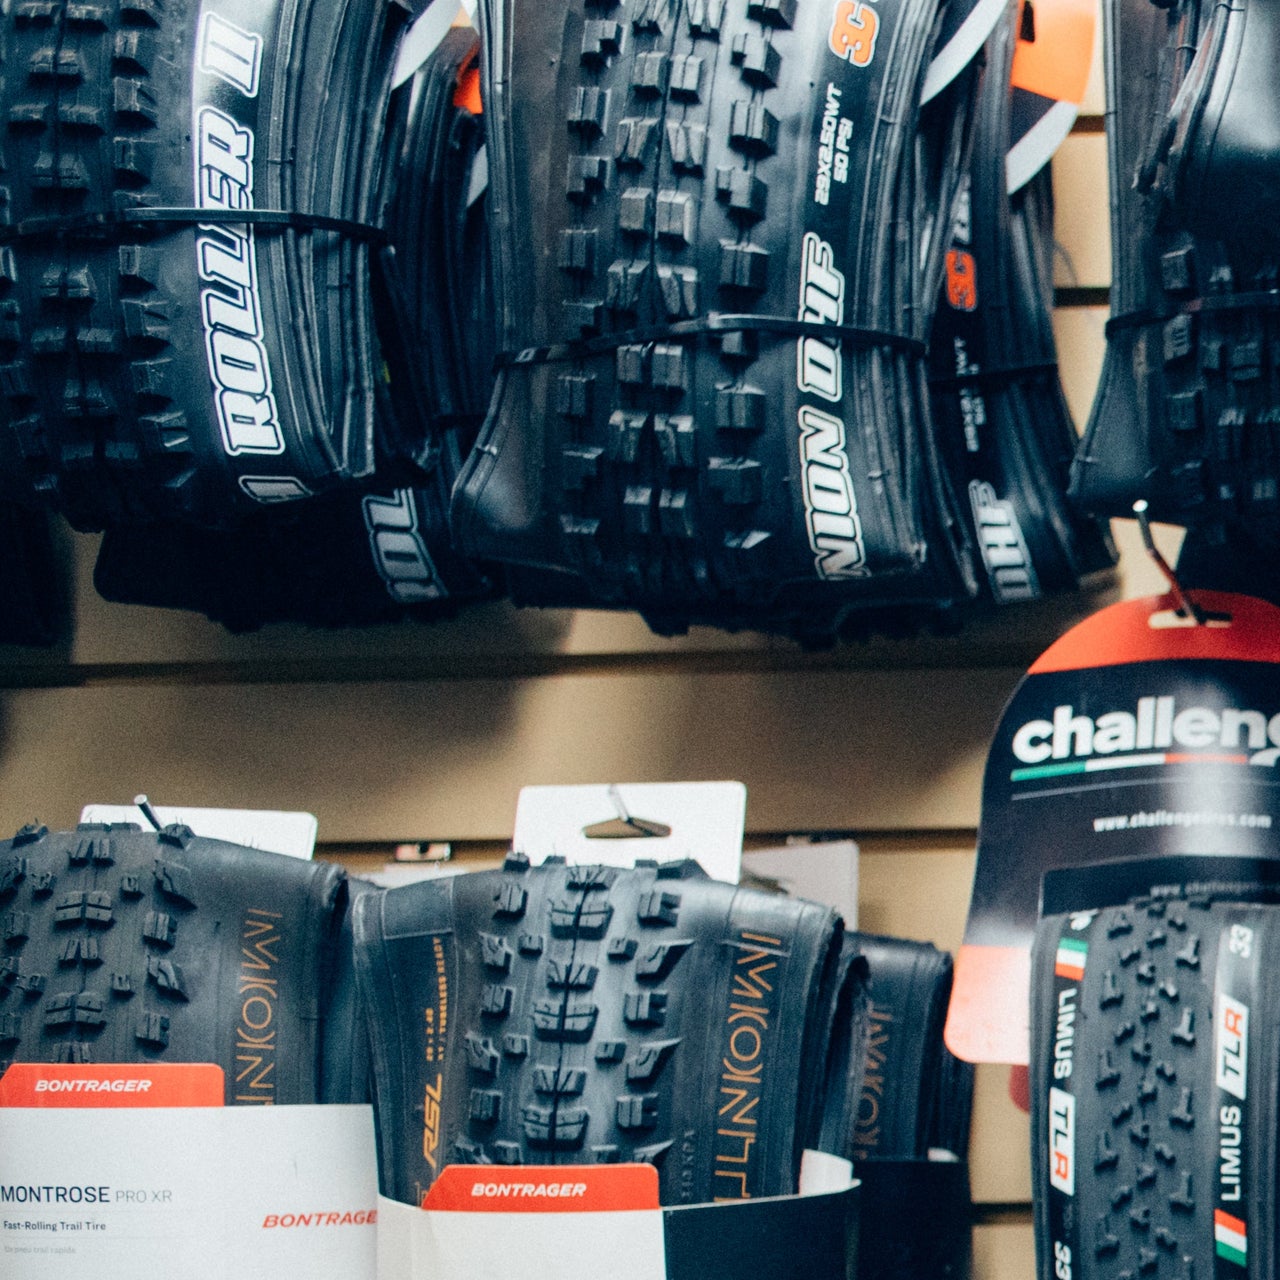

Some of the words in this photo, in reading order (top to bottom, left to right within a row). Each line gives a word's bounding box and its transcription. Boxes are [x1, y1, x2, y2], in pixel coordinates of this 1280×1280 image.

[1053, 988, 1077, 1081] LIMUS
[34, 1079, 153, 1093] BONTRAGER
[423, 1073, 443, 1167] RSL
[1219, 1104, 1242, 1202] LIMUS
[0, 1184, 111, 1204] MONTROSE
[115, 1189, 148, 1204] PRO
[151, 1188, 173, 1203] XR
[471, 1182, 588, 1198] BONTRAGER
[3, 1220, 59, 1233] Fast-Rolling
[60, 1220, 85, 1232] Trail
[86, 1220, 107, 1232] Tire
